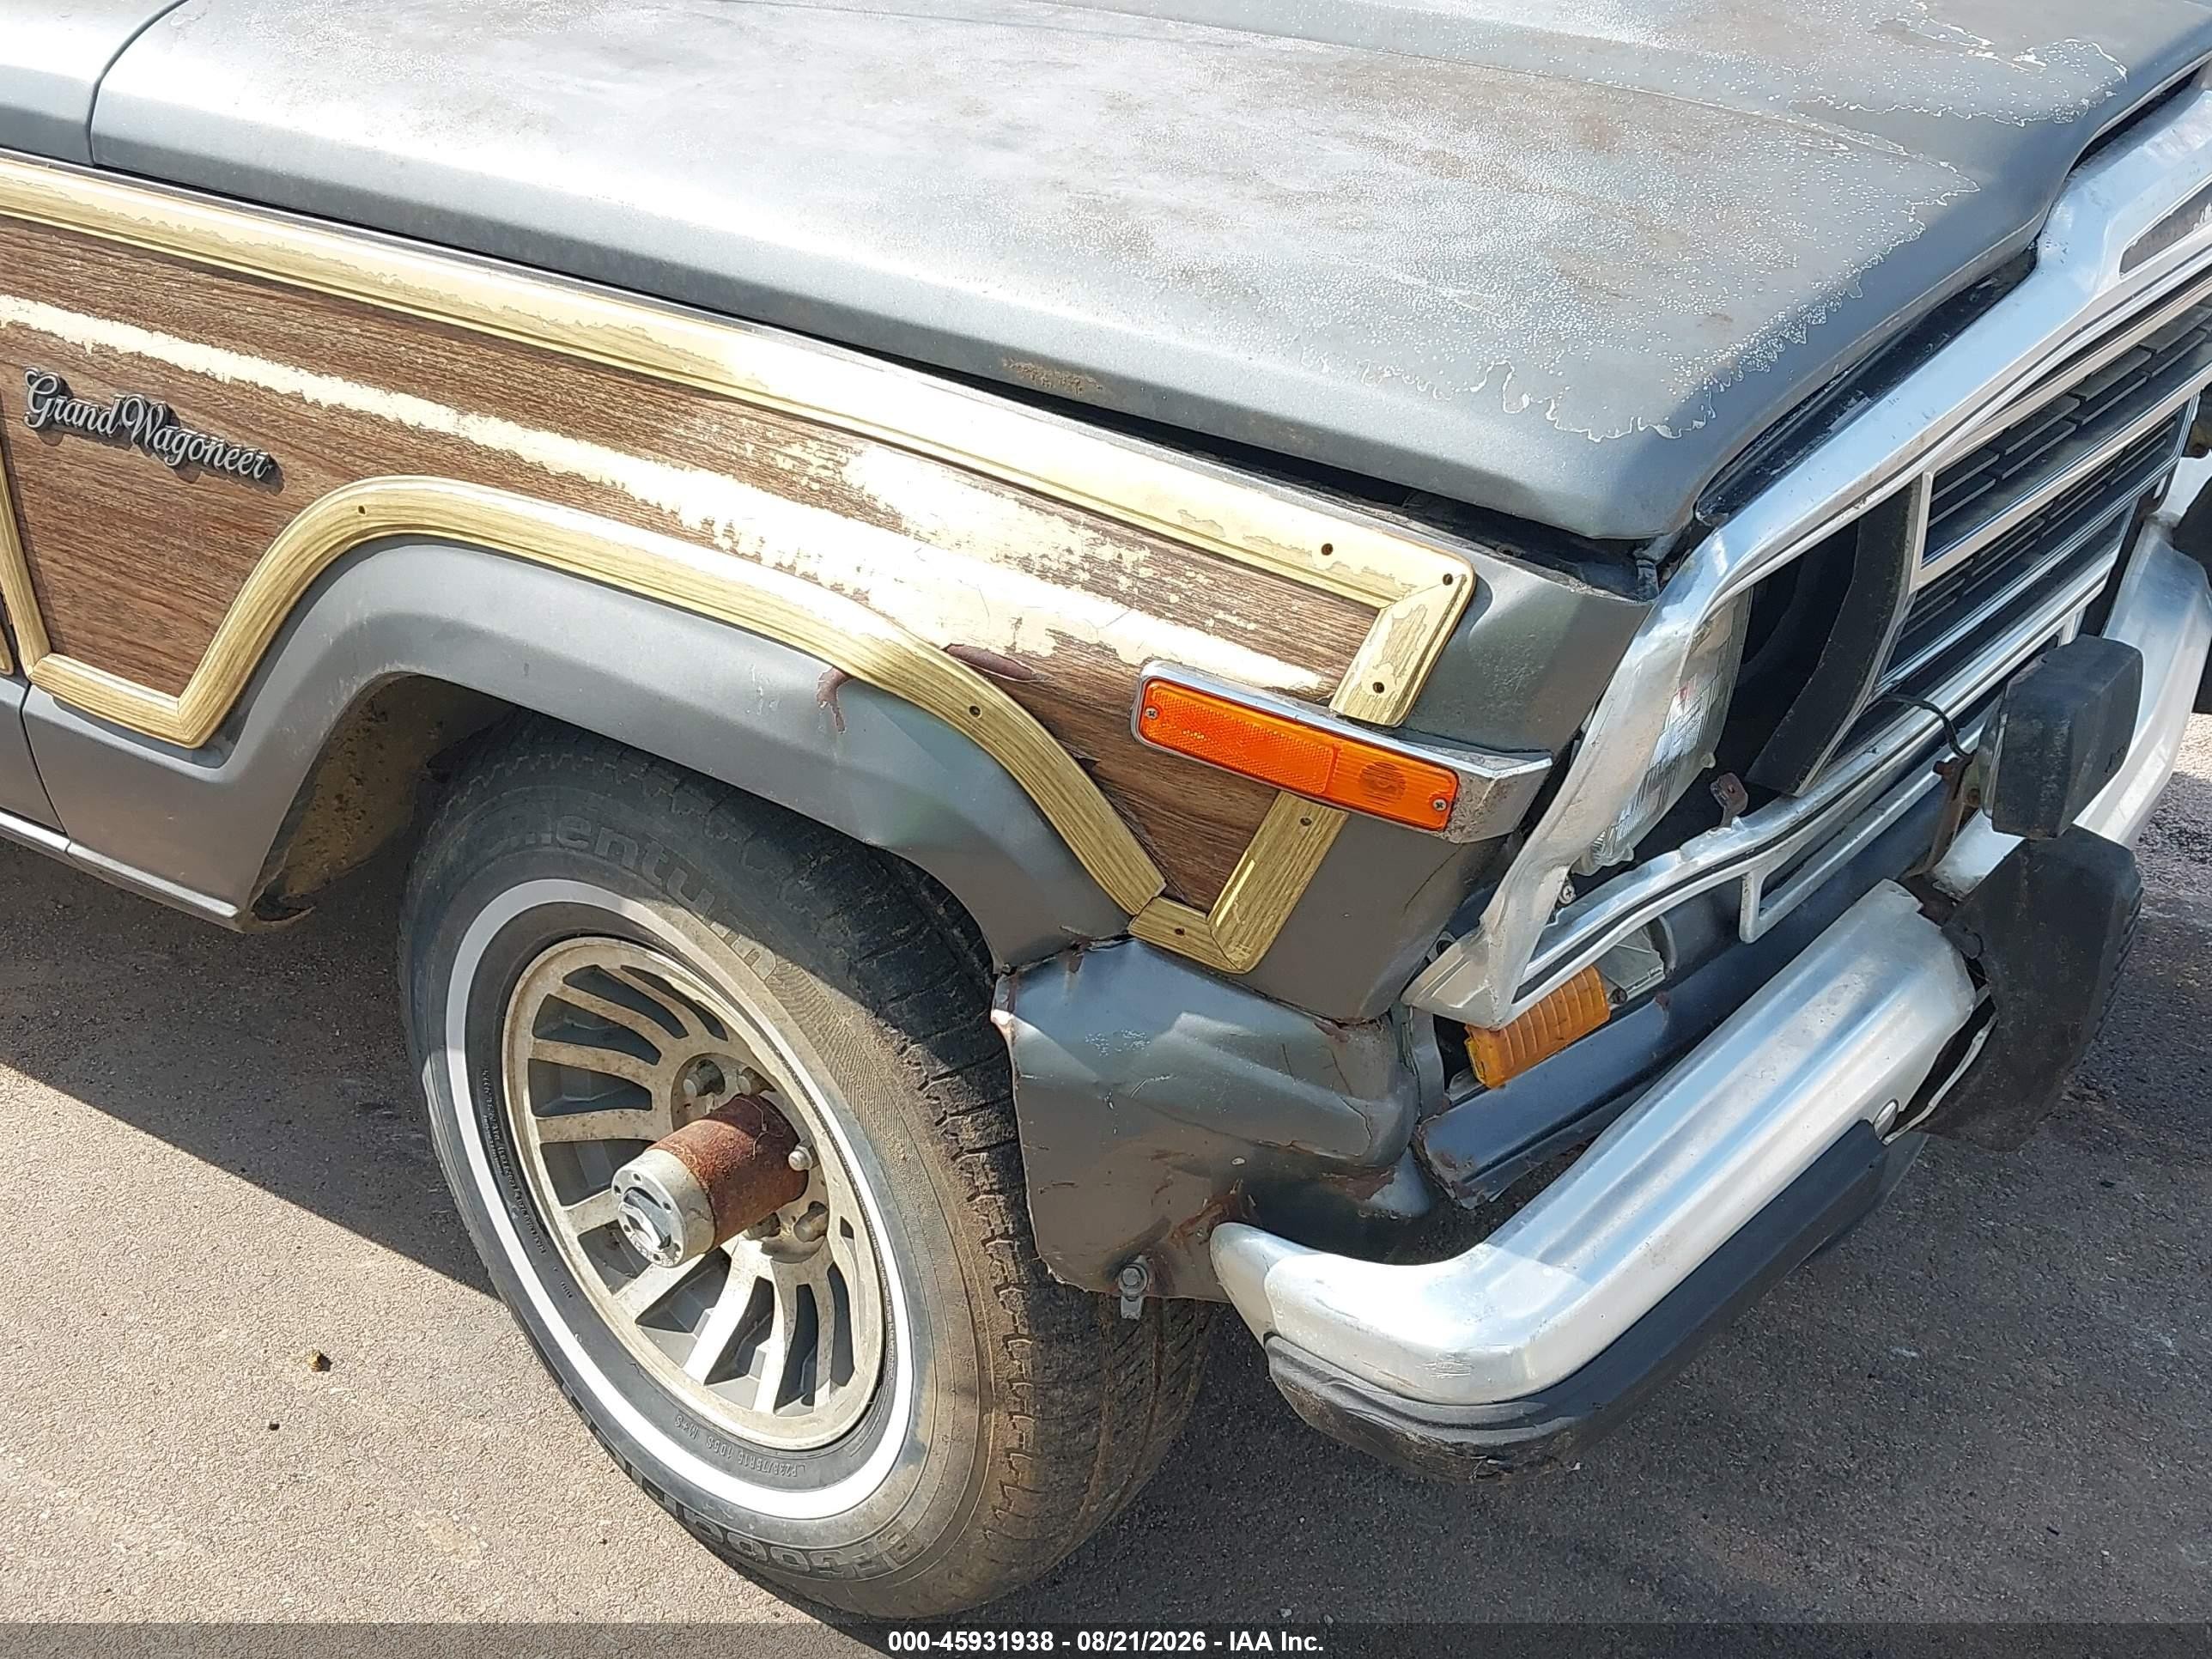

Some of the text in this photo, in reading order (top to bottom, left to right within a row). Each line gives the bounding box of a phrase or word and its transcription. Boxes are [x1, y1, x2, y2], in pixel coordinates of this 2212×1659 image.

[23, 366, 274, 482] Grand Wagoneer
[464, 811, 777, 986] mentum
